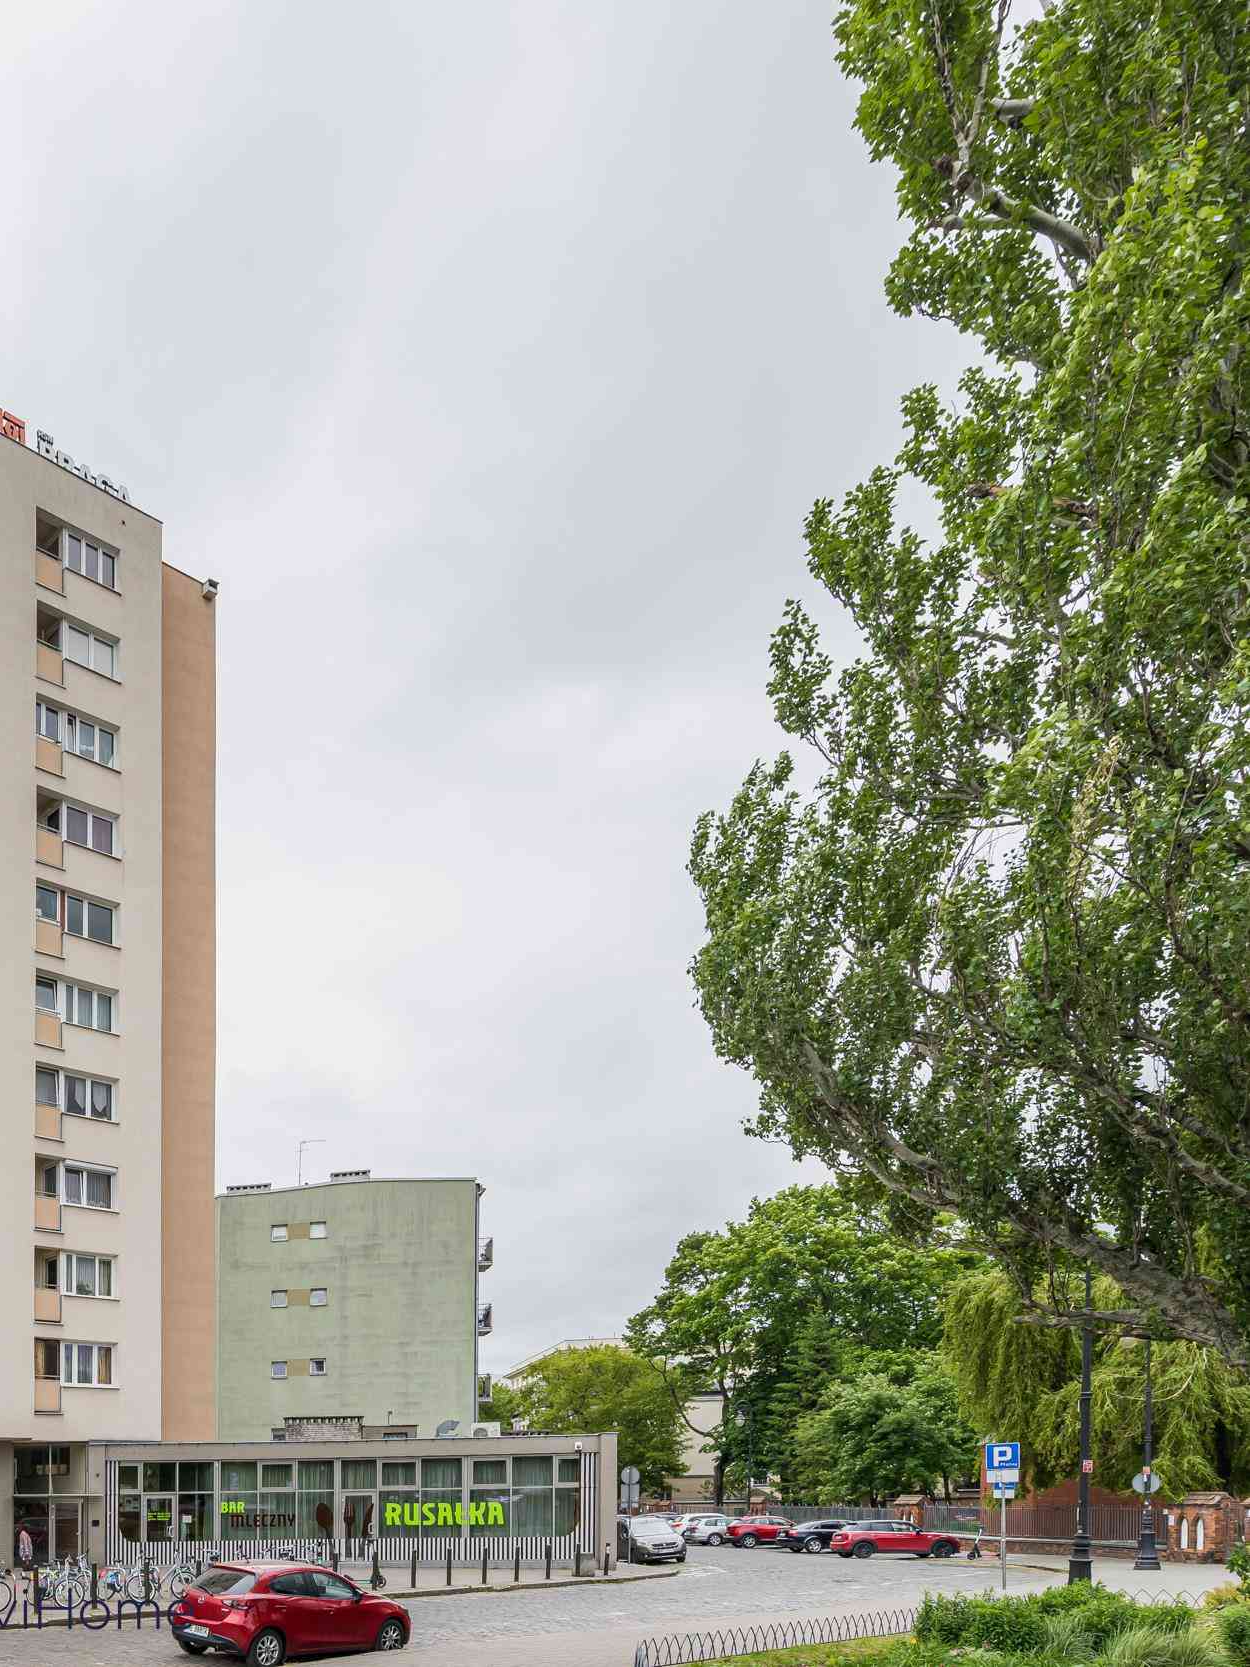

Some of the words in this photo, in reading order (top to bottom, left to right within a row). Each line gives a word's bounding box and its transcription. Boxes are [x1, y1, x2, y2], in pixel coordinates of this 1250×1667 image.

[993, 1446, 1012, 1467] P
[221, 1501, 245, 1514] BAR
[384, 1502, 505, 1527] RUSAŁKA
[230, 1514, 295, 1528] MLECZNY
